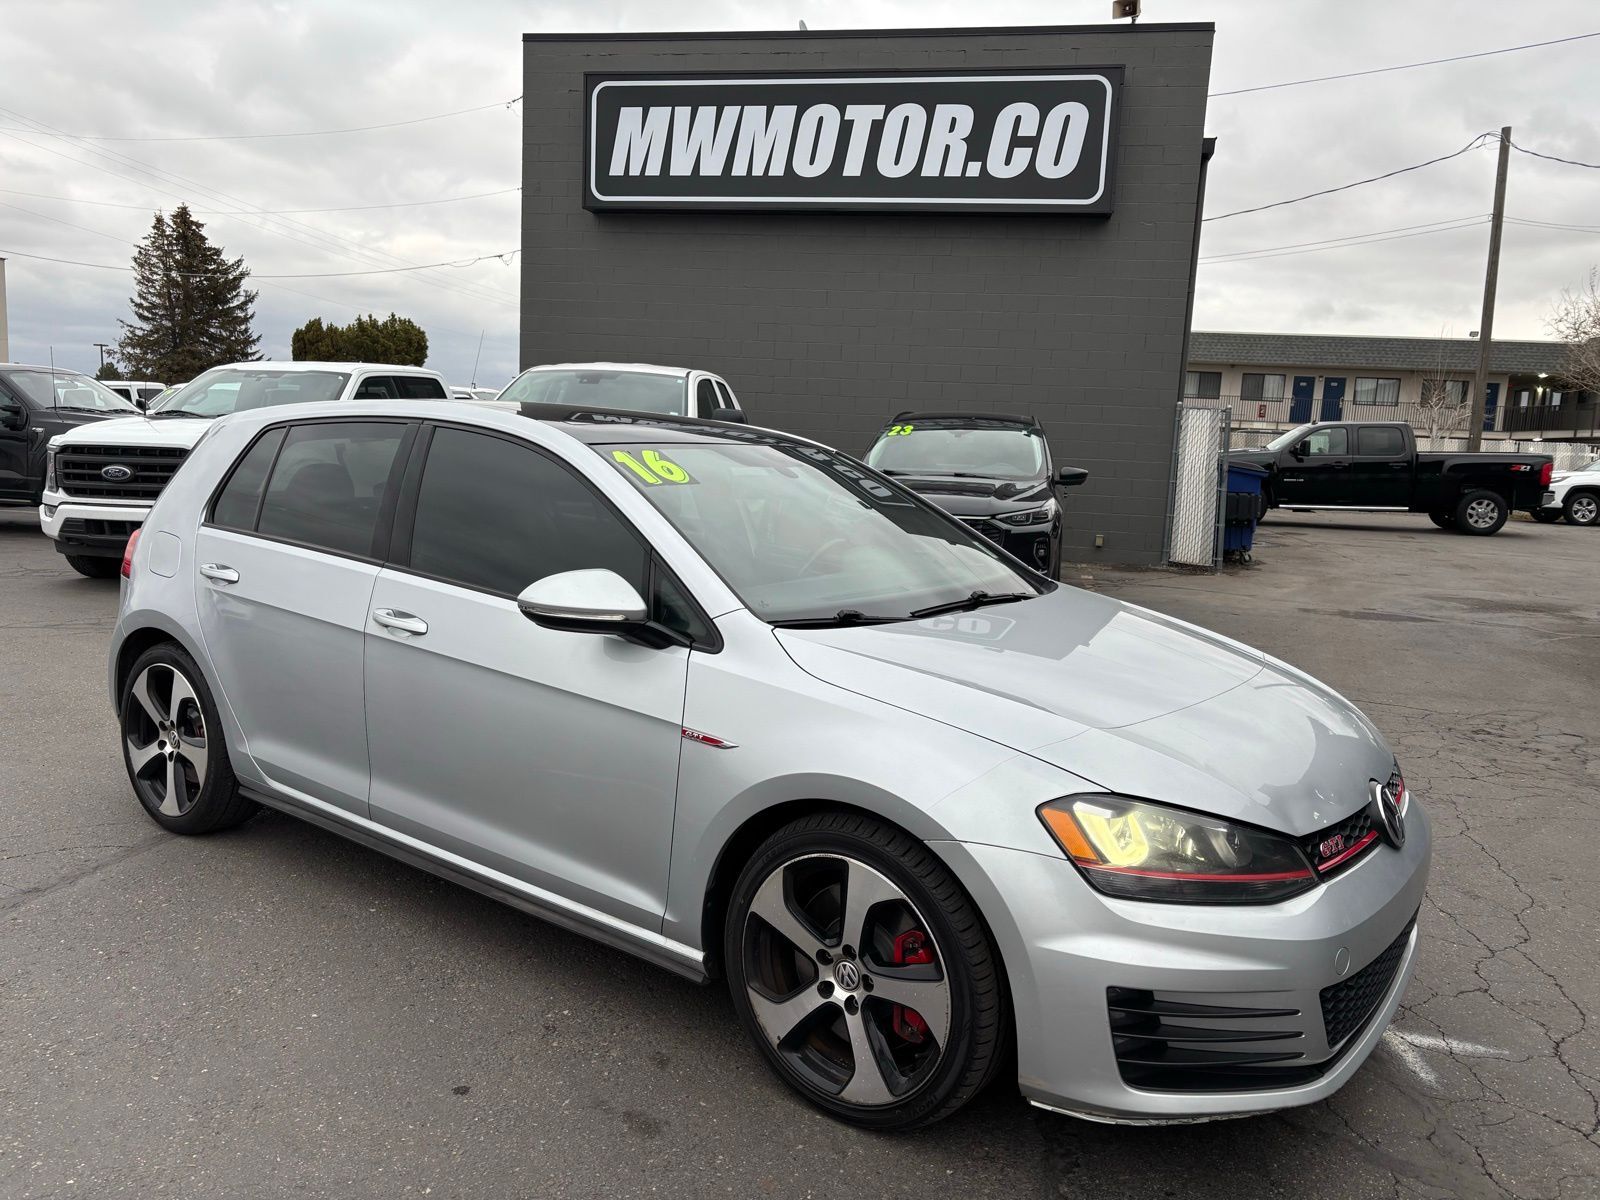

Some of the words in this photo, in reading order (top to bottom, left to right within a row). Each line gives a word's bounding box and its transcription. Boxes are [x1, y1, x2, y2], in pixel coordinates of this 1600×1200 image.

[608, 101, 1090, 179] MWMOTOR.CO
[887, 425, 914, 436] 23
[612, 449, 690, 485] 16
[1320, 834, 1345, 858] GTI
